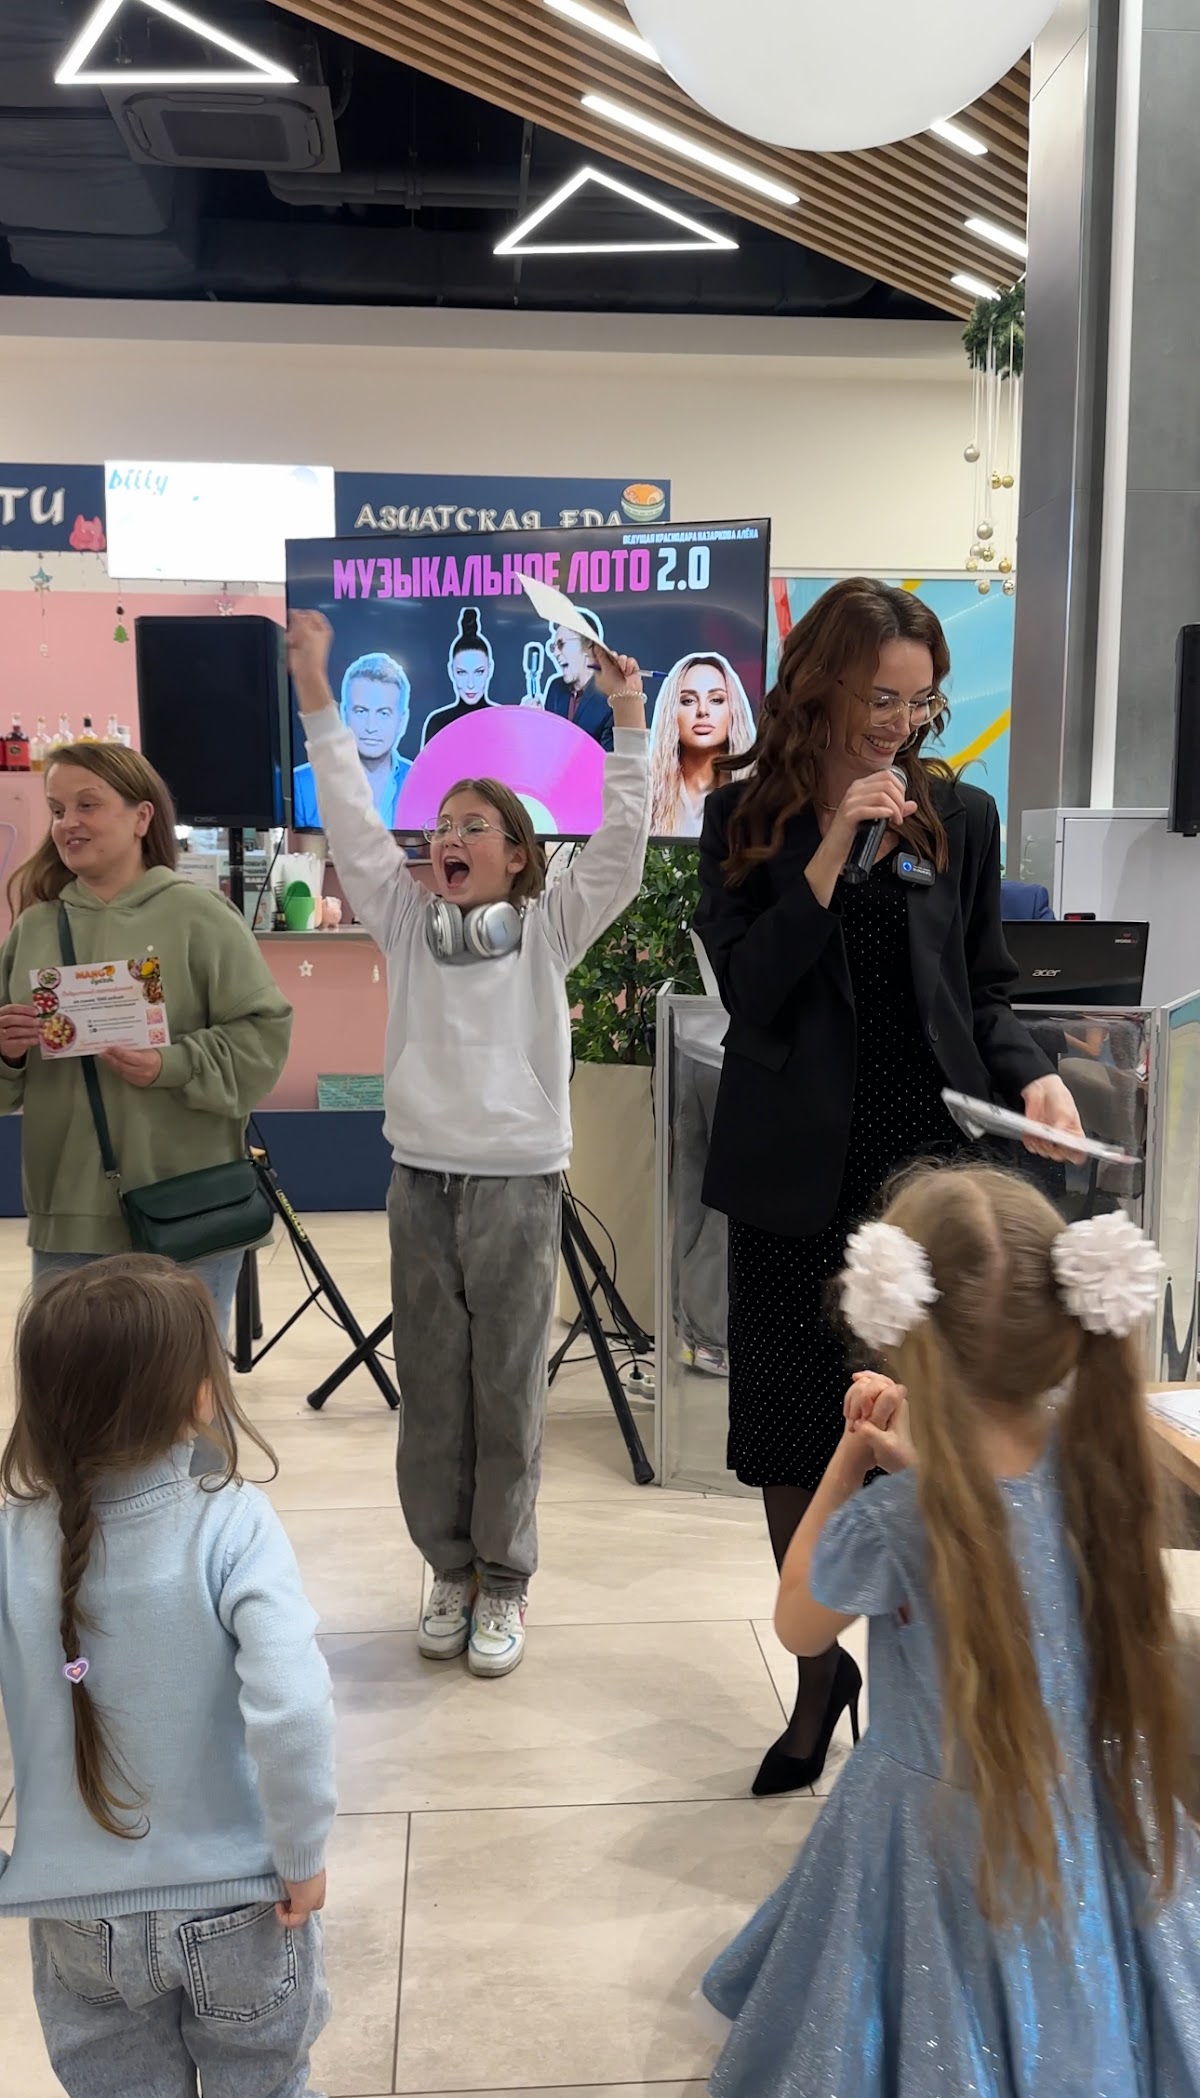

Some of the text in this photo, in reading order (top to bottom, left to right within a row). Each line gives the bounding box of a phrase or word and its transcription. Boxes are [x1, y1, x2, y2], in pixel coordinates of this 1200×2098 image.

[354, 503, 623, 532] АЗИАТСКАЯ ЕДА
[623, 534, 655, 544] ВЕДУЩАЯ
[333, 546, 710, 600] МУЗЫКАЛЬНОЕ ЛОТО 2.0
[1032, 969, 1061, 977] acer
